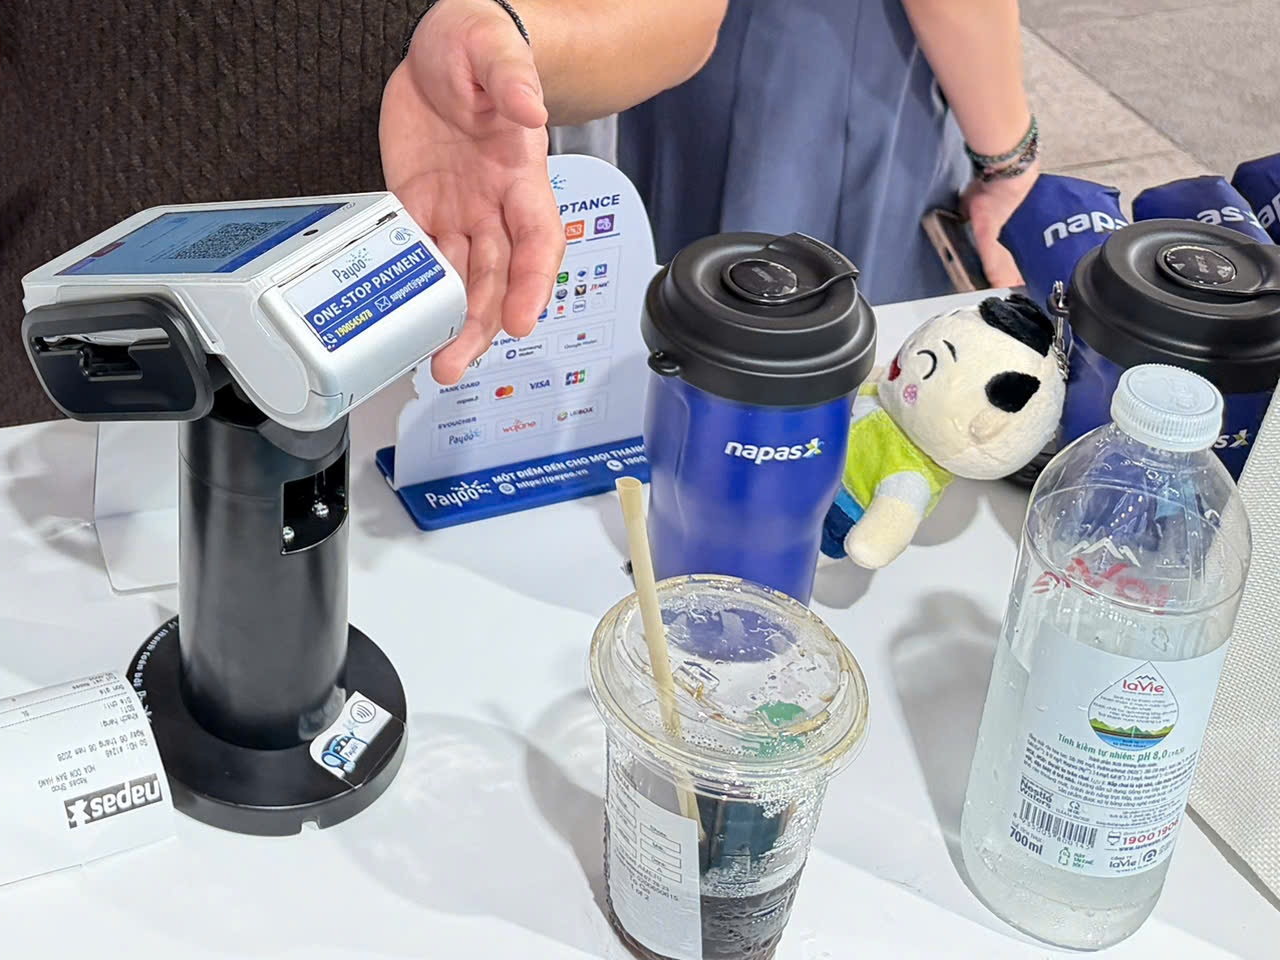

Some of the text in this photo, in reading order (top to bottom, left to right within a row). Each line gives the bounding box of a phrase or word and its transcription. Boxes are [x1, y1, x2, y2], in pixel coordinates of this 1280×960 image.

[557, 194, 620, 216] PTANCE
[332, 259, 366, 282] Payoo
[313, 248, 426, 326] ONE-STOP PAYMENT
[529, 380, 550, 390] VISA
[425, 486, 479, 509] Payoo
[1137, 752, 1151, 762] pH
[1123, 832, 1154, 845] 1900
